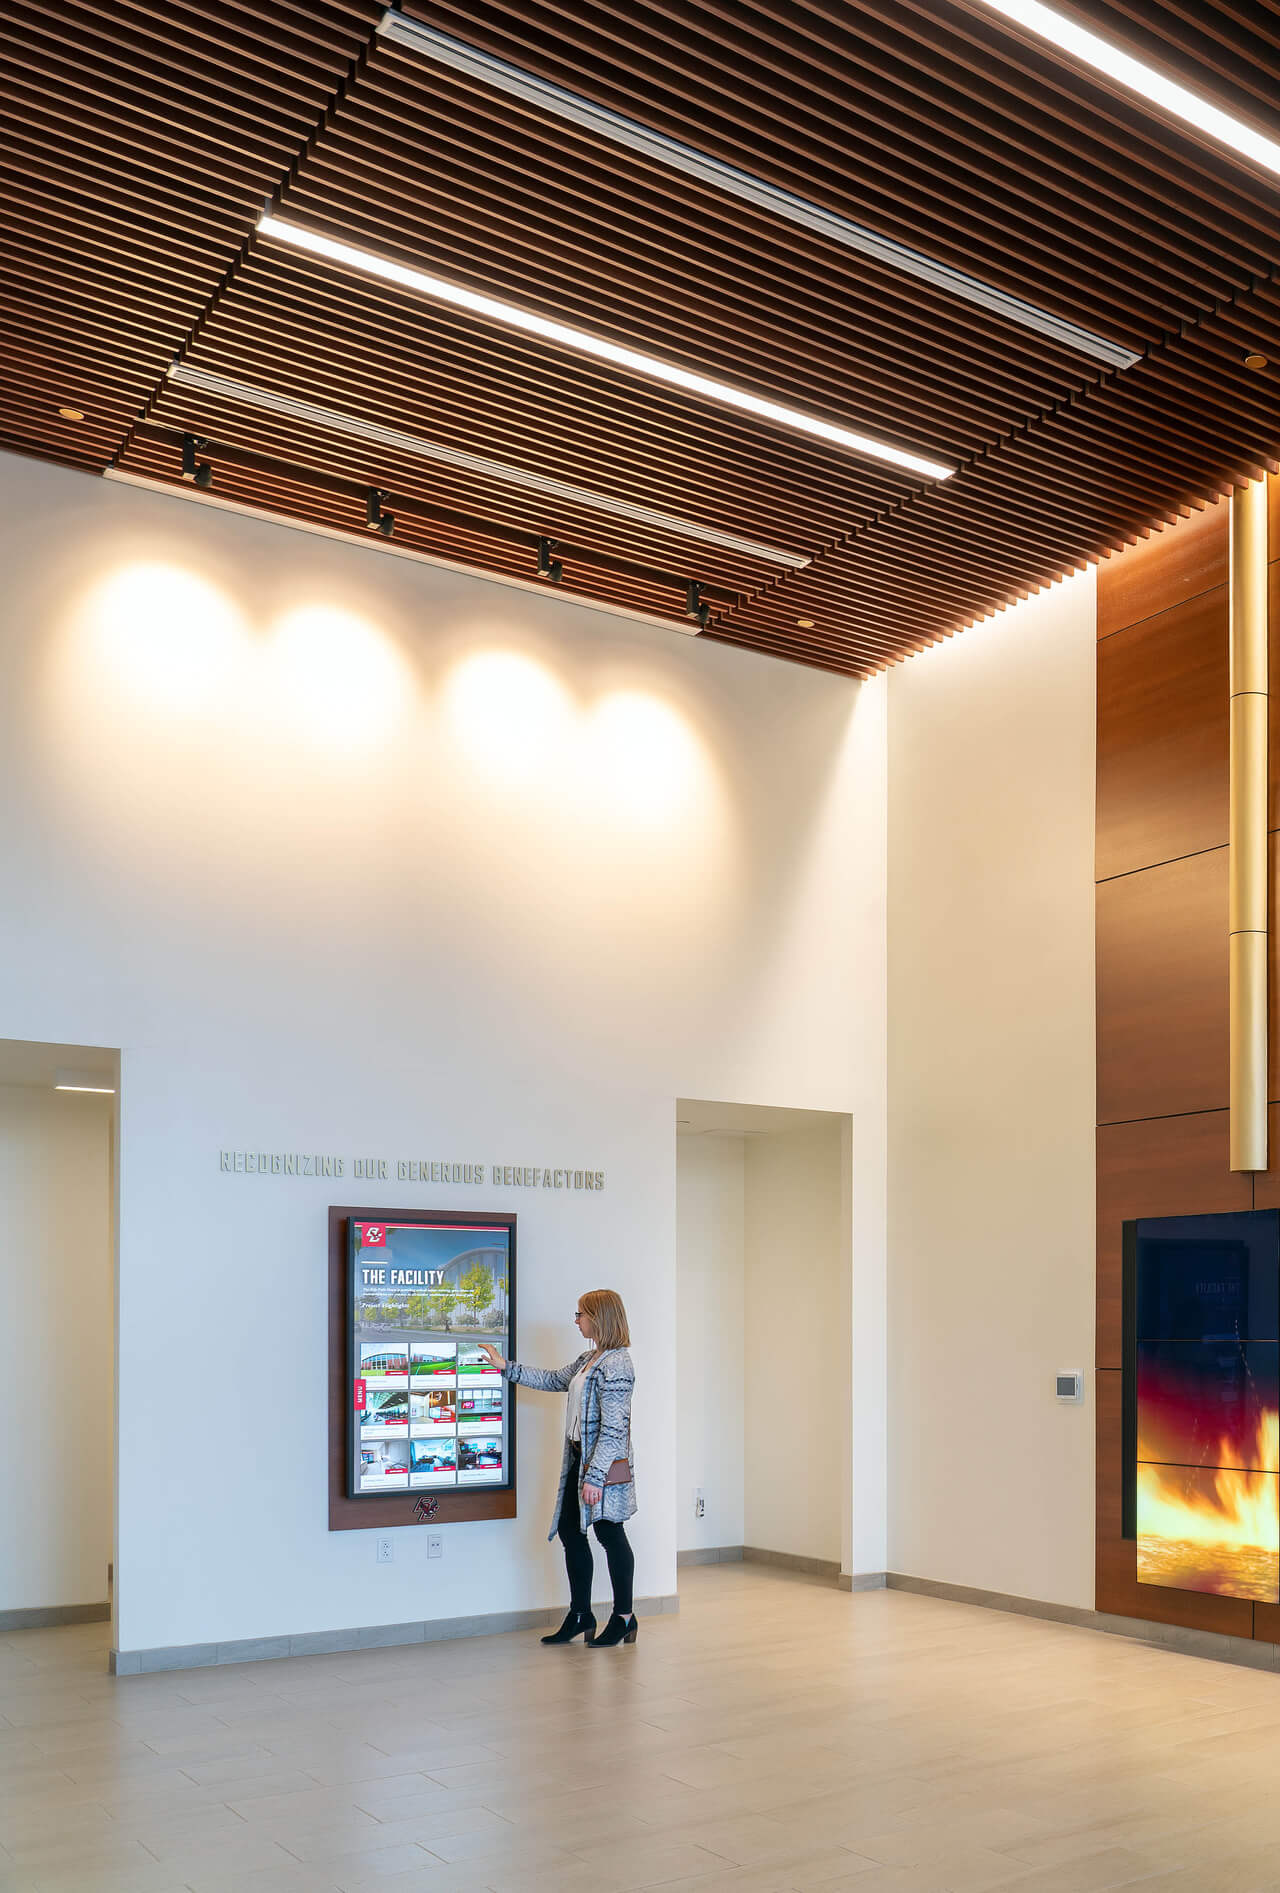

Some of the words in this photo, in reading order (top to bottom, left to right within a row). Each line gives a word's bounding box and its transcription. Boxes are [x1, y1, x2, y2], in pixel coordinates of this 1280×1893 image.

[220, 1150, 344, 1177] RECOGNIZING
[353, 1158, 388, 1180] OUR
[397, 1159, 484, 1185] GENEROUS
[493, 1166, 605, 1191] BENEFACTORS
[362, 1269, 386, 1285] THE
[391, 1269, 444, 1286] FACILITY
